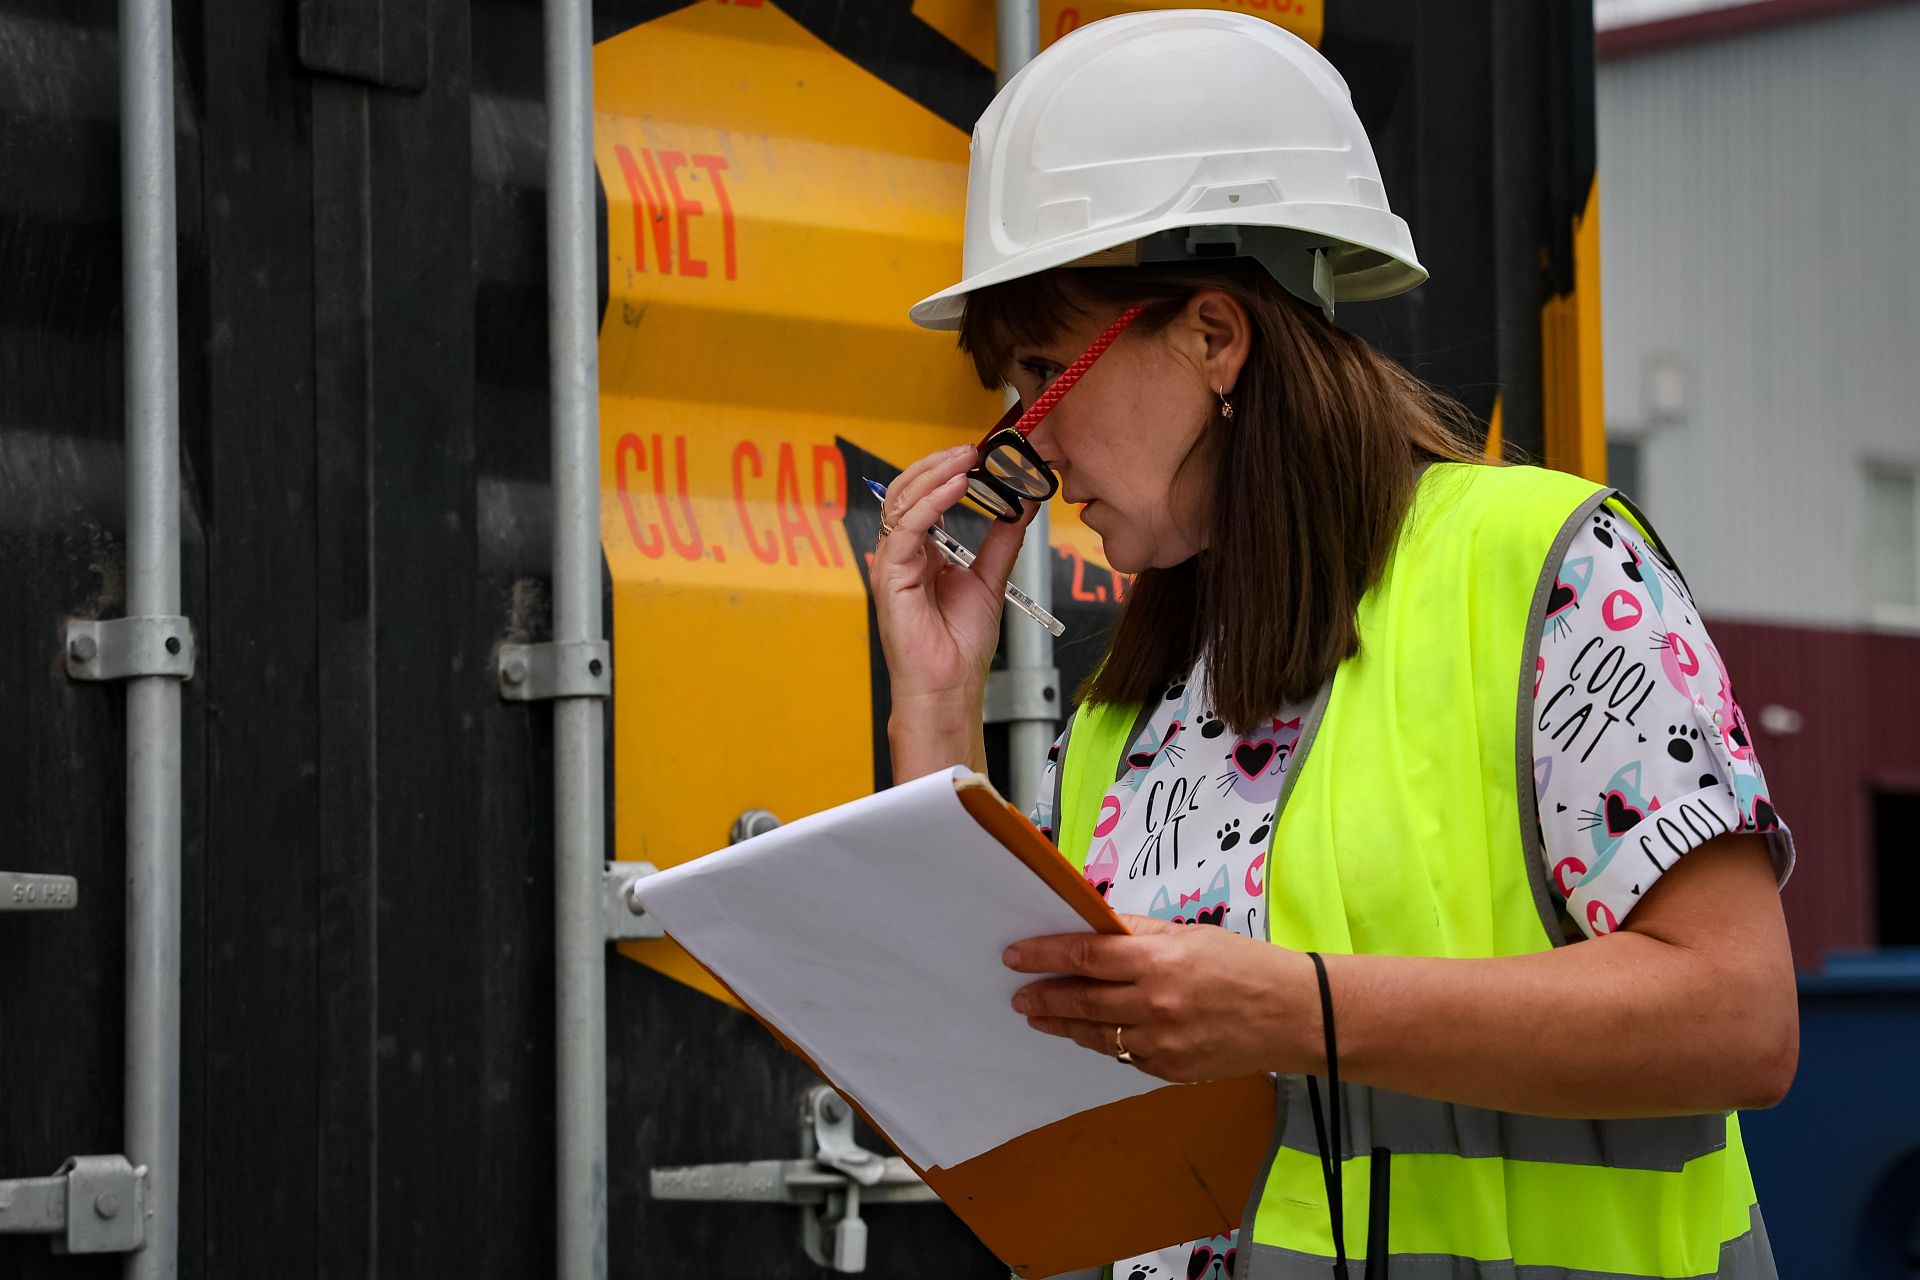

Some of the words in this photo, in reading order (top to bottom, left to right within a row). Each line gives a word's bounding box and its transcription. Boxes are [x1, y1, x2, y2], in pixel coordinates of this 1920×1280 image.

[614, 144, 738, 281] NET
[615, 431, 727, 564] CU.
[1538, 683, 1621, 763] CAT
[1569, 636, 1656, 727] COOL
